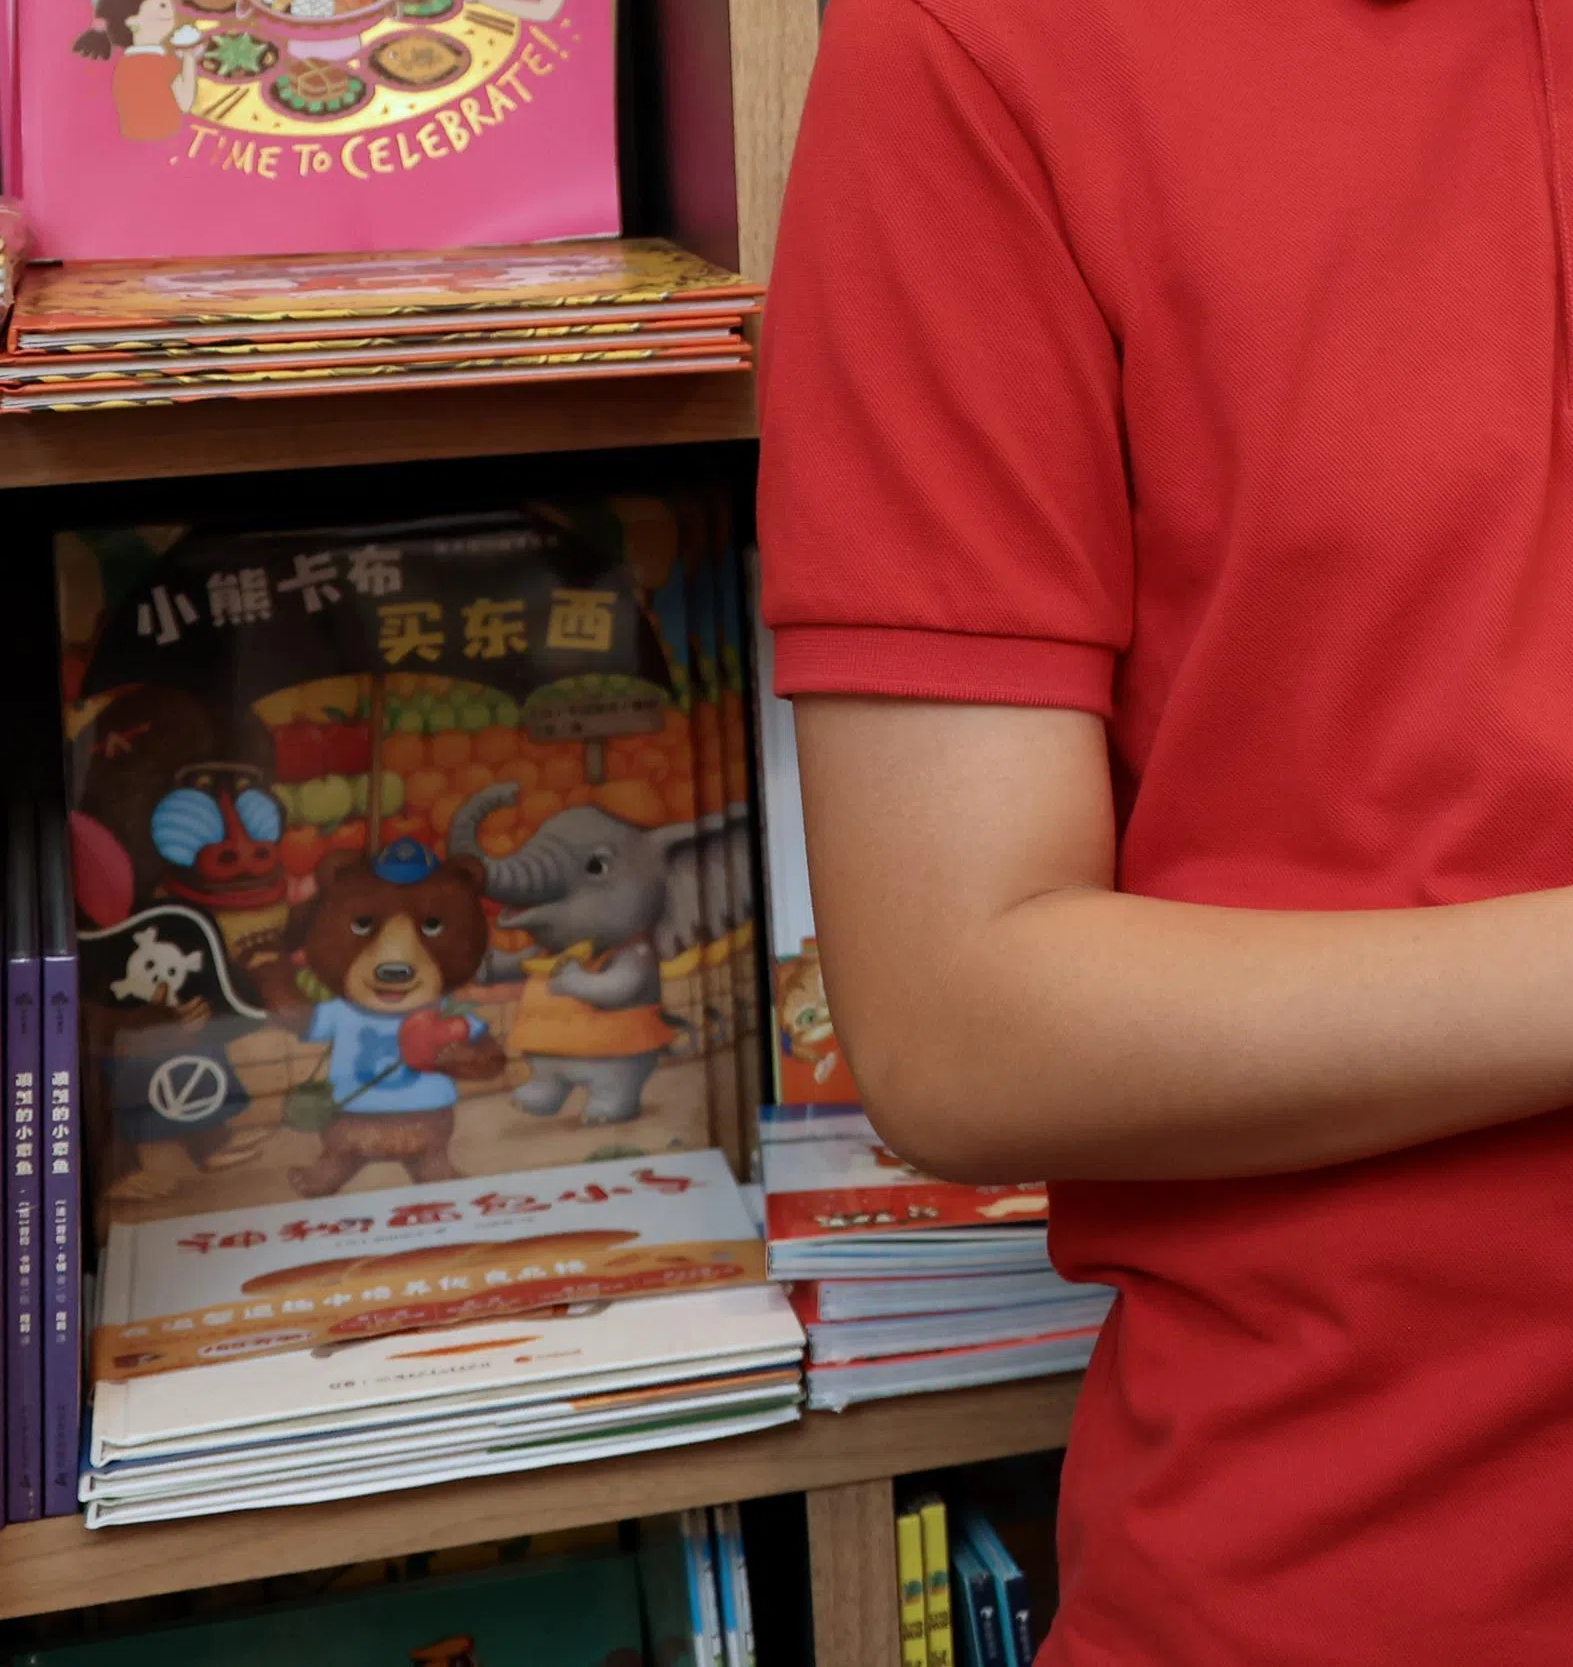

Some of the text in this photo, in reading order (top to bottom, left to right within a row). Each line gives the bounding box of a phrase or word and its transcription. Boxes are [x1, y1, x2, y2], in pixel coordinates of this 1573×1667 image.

[187, 122, 279, 179] TIME
[341, 20, 574, 179] CELEBRATE!
[136, 543, 405, 647] 小熊卡布
[377, 589, 618, 664] 买东西
